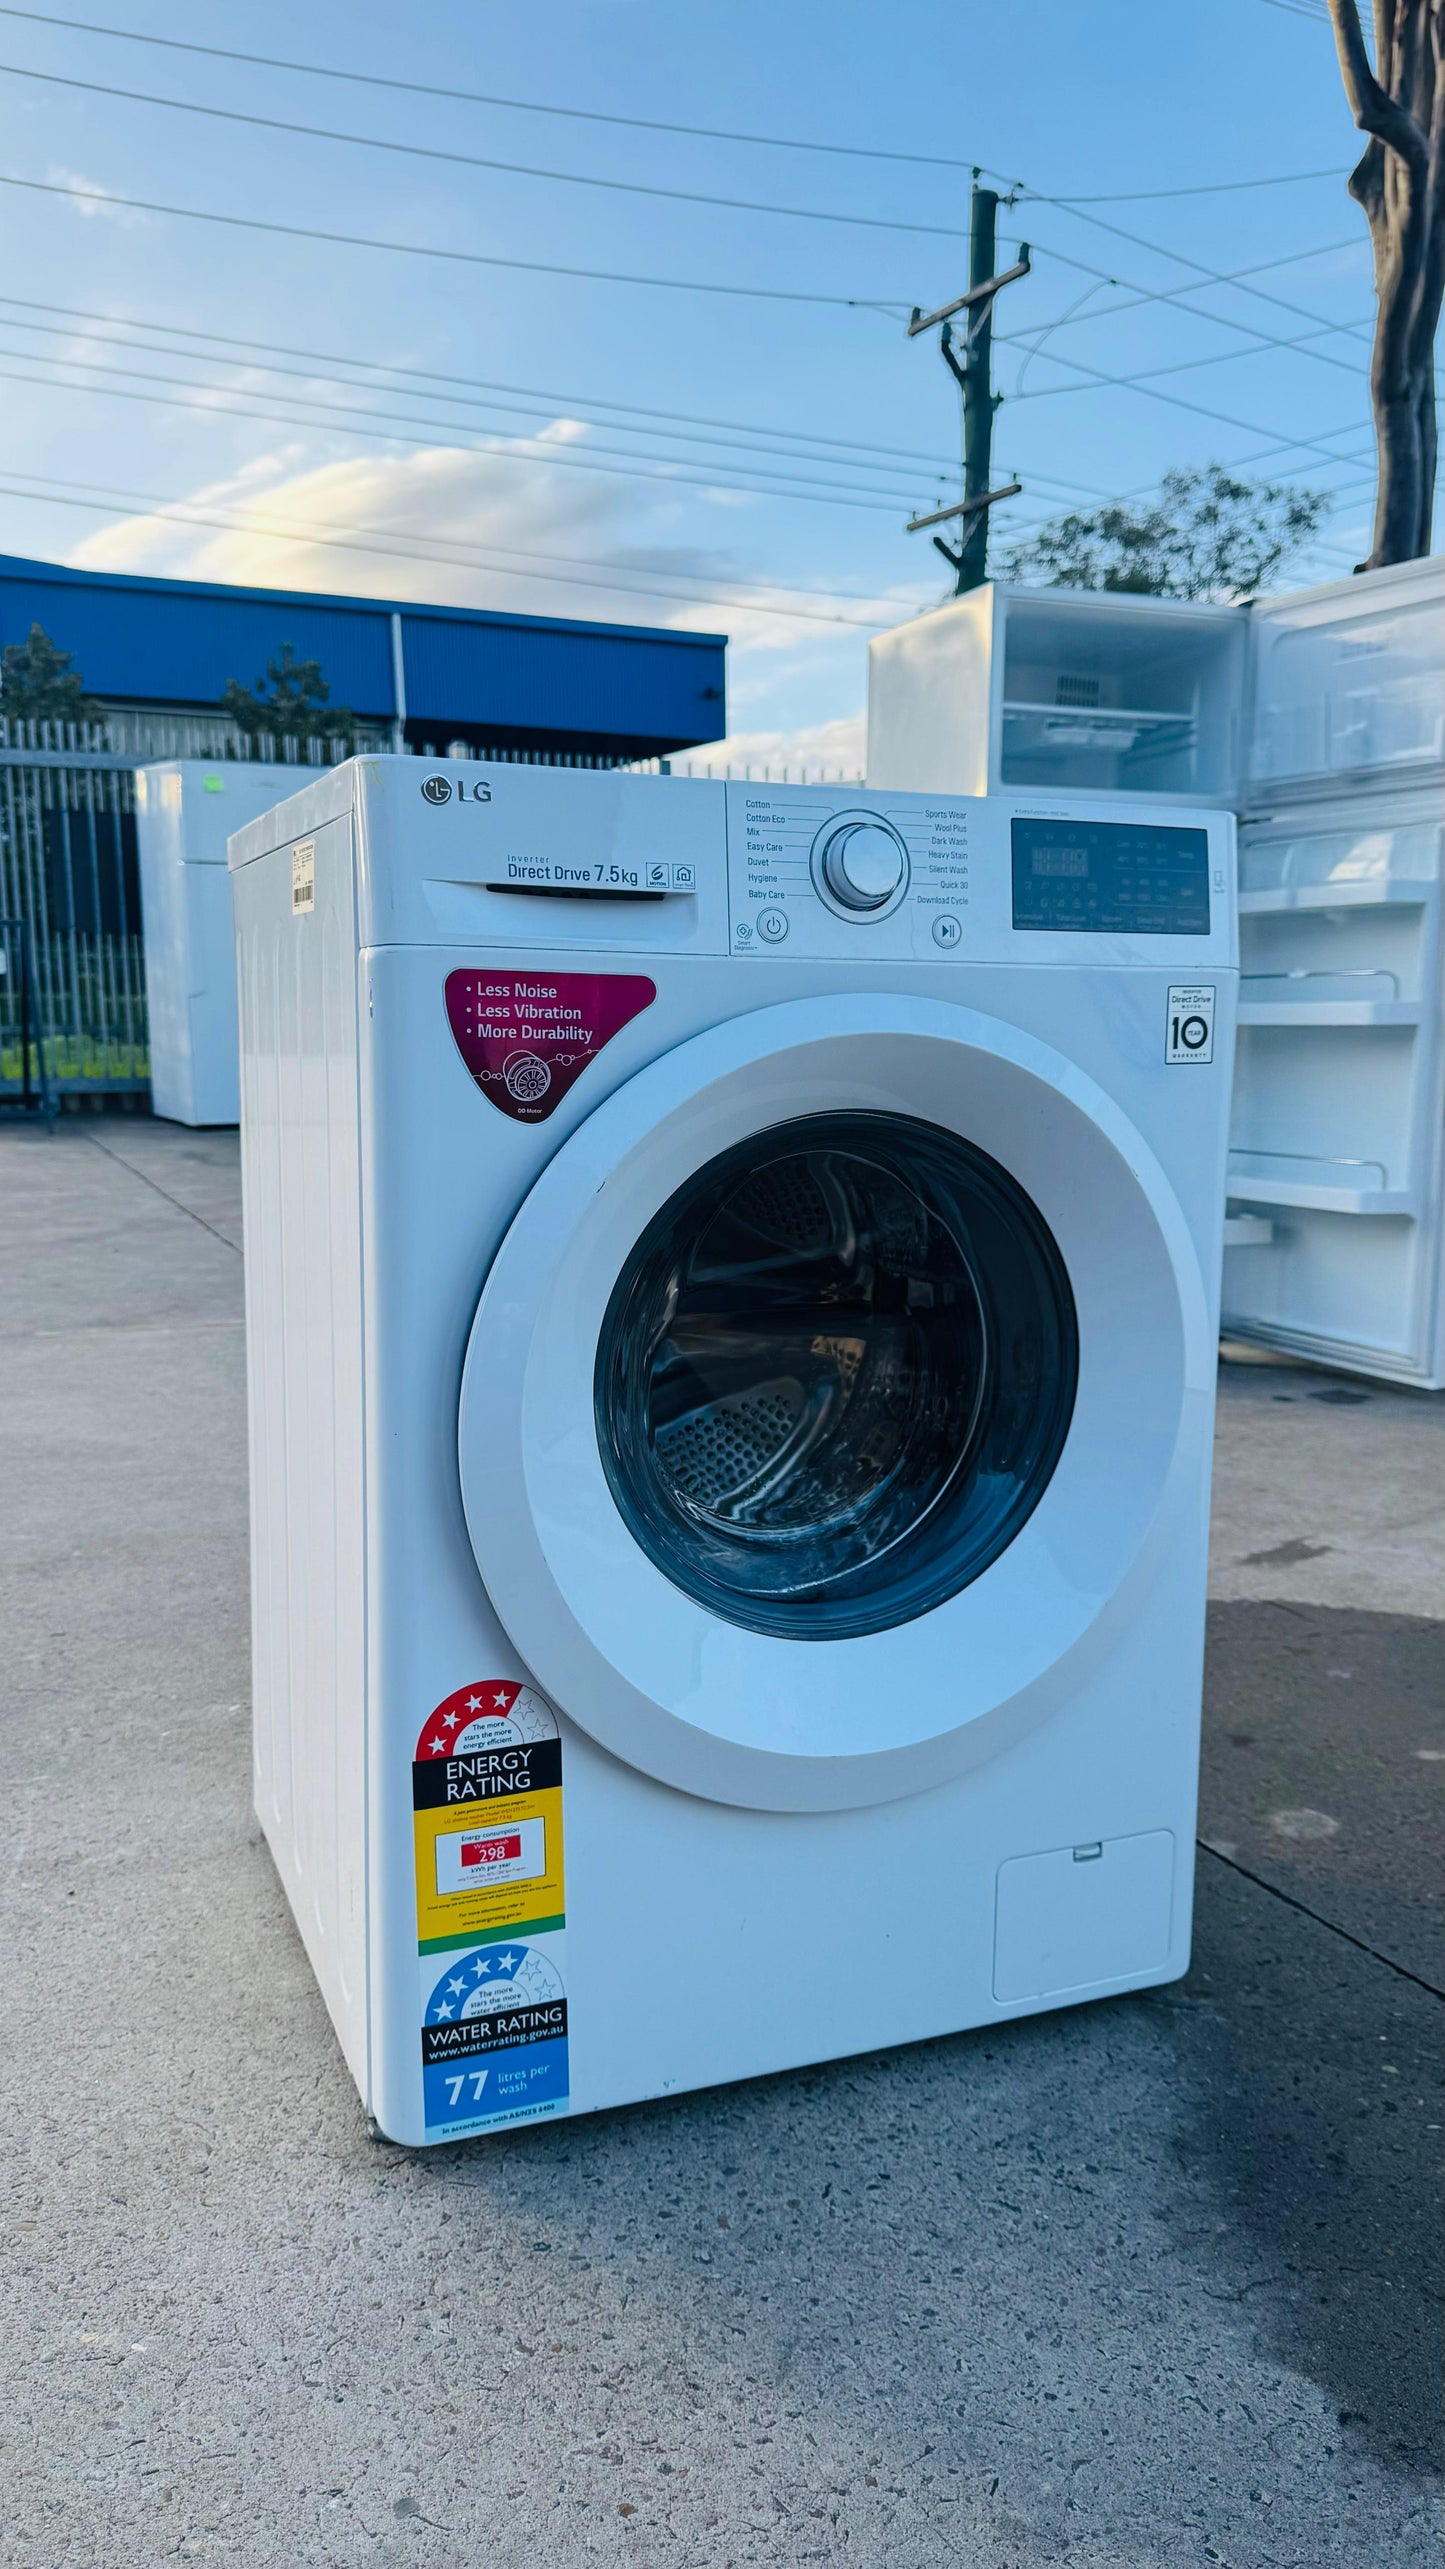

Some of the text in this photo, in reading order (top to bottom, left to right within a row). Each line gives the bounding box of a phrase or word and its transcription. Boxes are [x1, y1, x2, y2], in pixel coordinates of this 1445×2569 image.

[458, 780, 492, 802] LG
[746, 799, 770, 808] Cotton
[746, 813, 786, 823] Cotton Eco
[925, 810, 967, 819] Sports Wear
[747, 827, 760, 836] Mix
[934, 824, 967, 832] Wool Plus
[747, 841, 783, 852] Easy Care
[931, 836, 967, 846] Dark Wash
[507, 854, 550, 864] Inverter
[928, 850, 968, 860] Heavy Stain
[748, 857, 769, 867] Duvet
[508, 863, 551, 880] Direct
[555, 866, 591, 882] Drive
[929, 865, 968, 874] Silent Wash
[748, 873, 778, 884] Hygiene
[940, 880, 968, 889] Quick 30
[749, 889, 785, 900] Baby Care
[917, 895, 968, 905] Download Cycle
[477, 981, 557, 998] Less Noise
[1172, 995, 1211, 1003] Direct Drive
[477, 1003, 582, 1020] Less Vibration
[477, 1023, 593, 1045] More Durability
[1172, 1015, 1208, 1050] 10
[472, 1720, 505, 1732] The more
[464, 1728, 512, 1742] stars the more
[463, 1736, 513, 1750] energy efficient
[446, 1749, 533, 1780] ENERGY
[447, 1771, 531, 1801] RATING
[461, 1826, 520, 1842] Energy consumption
[474, 1842, 494, 1850] Warm
[479, 1846, 506, 1863] 298
[487, 1864, 497, 1872] per
[478, 1986, 513, 1999] The more
[470, 1993, 522, 2008] stars the more
[470, 2001, 520, 2016] water efficient
[429, 2007, 563, 2047] WATER RATING
[429, 2025, 564, 2060] www.waterrating.gov.au
[498, 2064, 550, 2083] litres per
[445, 2069, 489, 2106] 77
[498, 2082, 528, 2095] wash
[451, 2119, 491, 2133] accordance
[493, 2115, 509, 2124] with
